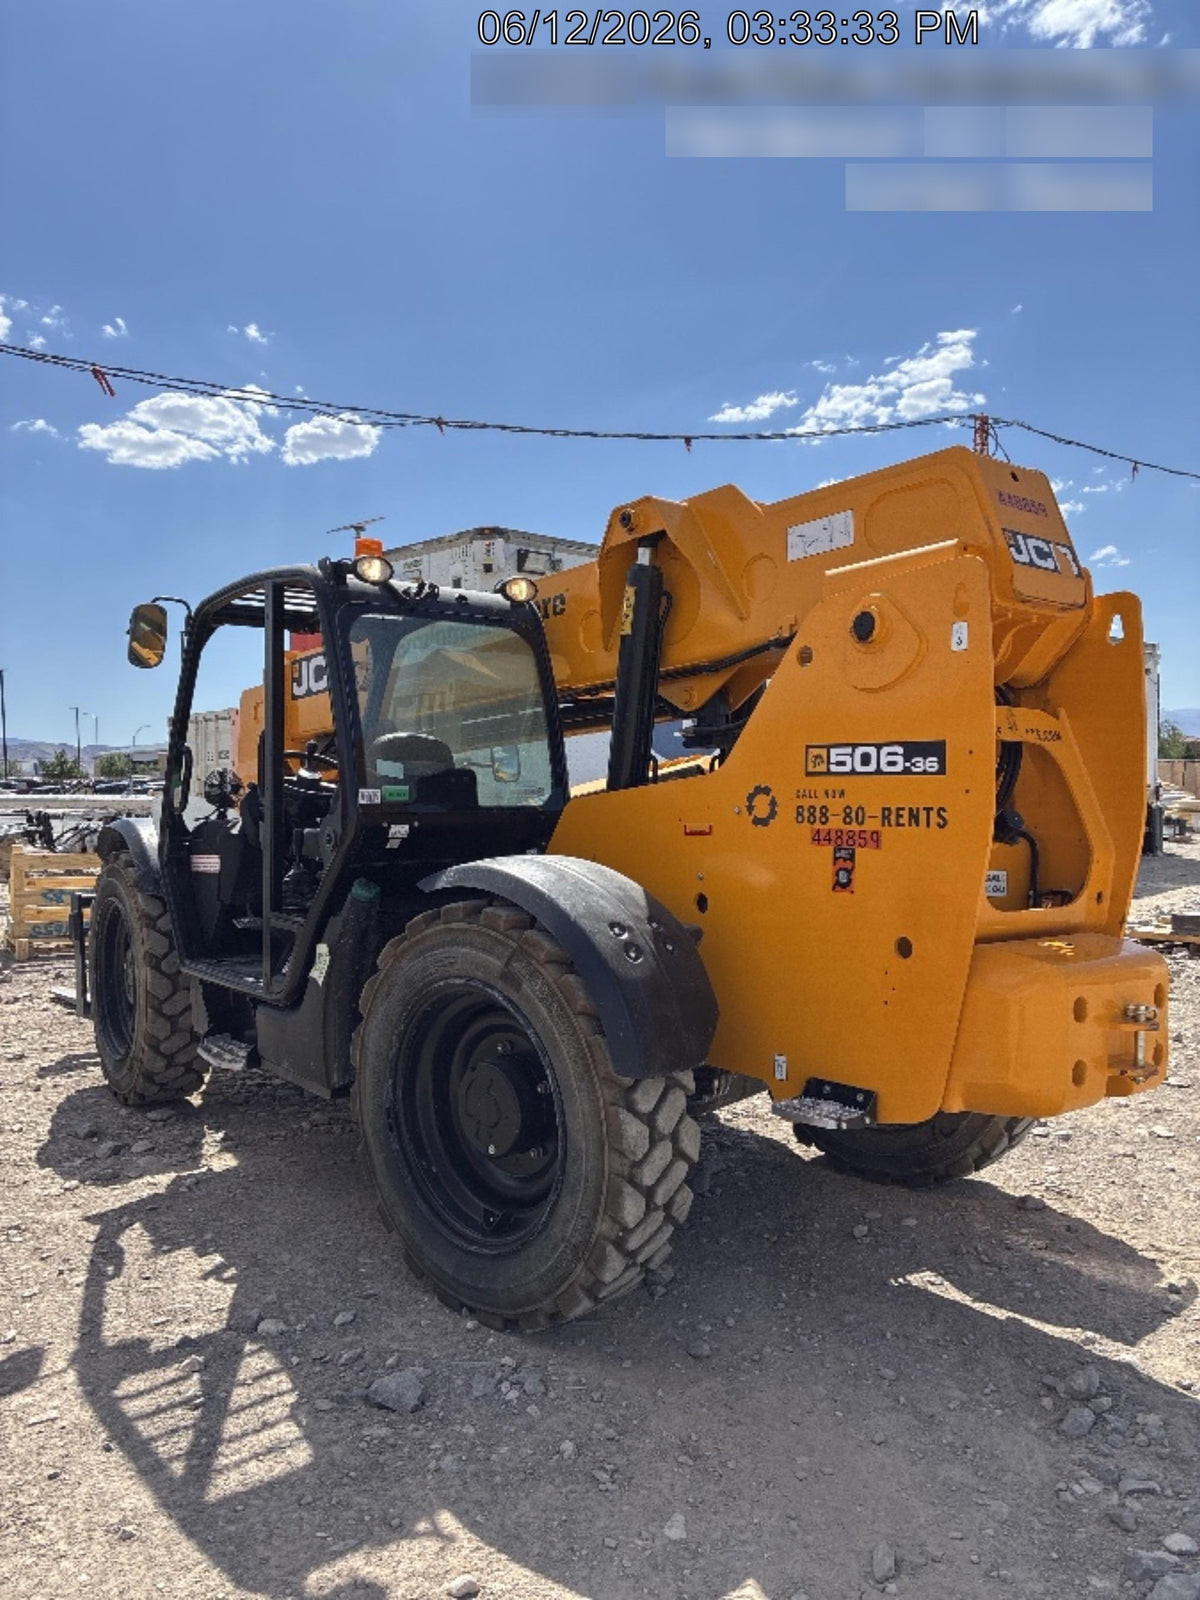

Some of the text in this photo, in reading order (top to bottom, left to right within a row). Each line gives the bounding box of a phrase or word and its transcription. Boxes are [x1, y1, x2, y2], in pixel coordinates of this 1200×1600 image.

[795, 788, 846, 799] CALL NOW
[795, 804, 949, 829] 888-80-RENTS
[812, 827, 880, 849] 448859
